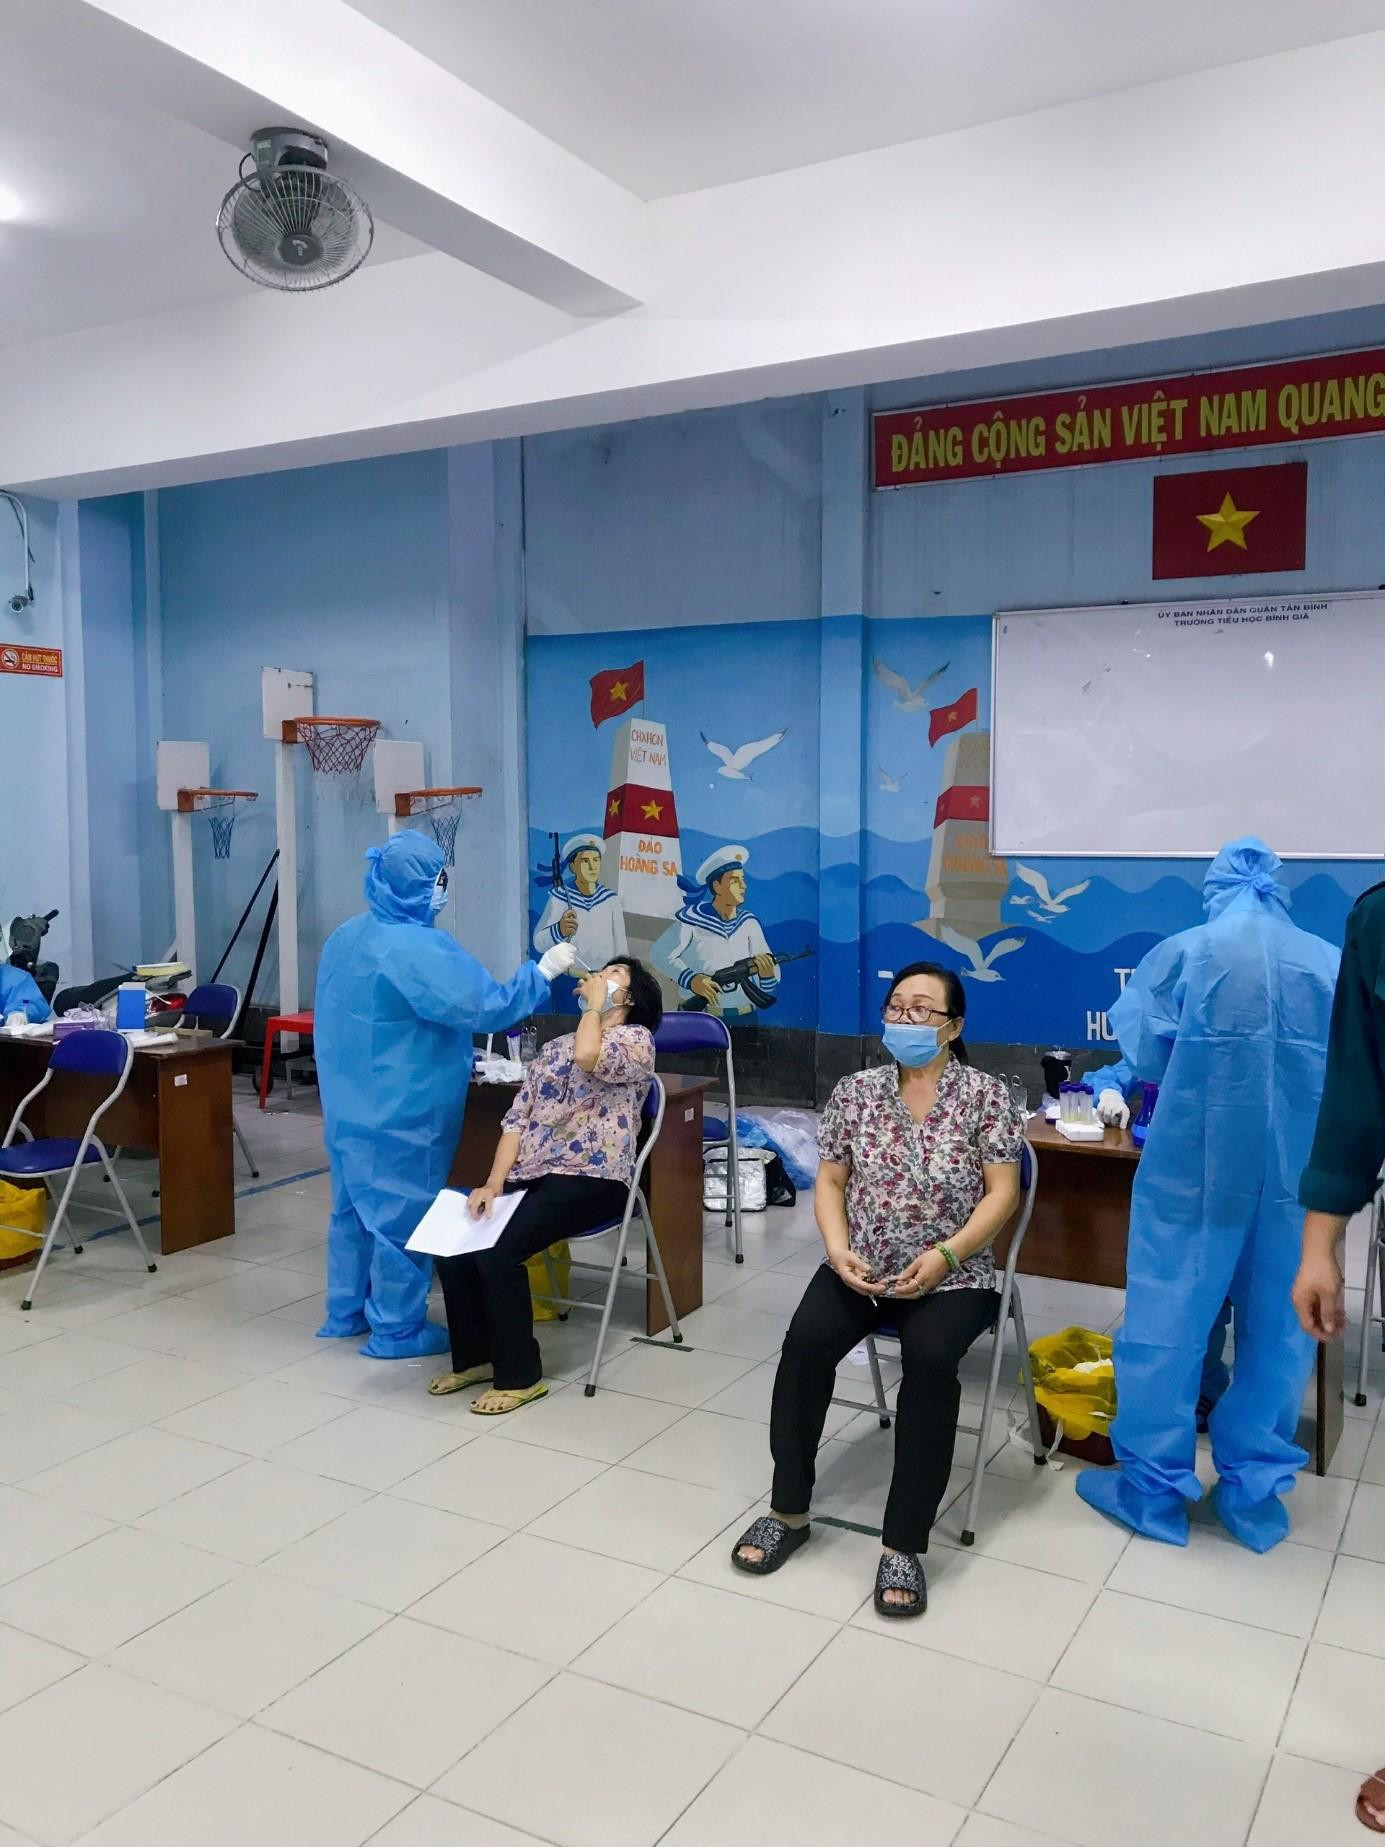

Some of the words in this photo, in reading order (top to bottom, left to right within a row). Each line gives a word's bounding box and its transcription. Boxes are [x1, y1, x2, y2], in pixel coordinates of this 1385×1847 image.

[890, 415, 964, 473] ĐẢNG
[971, 410, 1046, 469] CỘNG
[1055, 394, 1112, 454] SẢN
[1121, 389, 1189, 451] VIỆT
[1200, 388, 1267, 437] NAM
[1277, 372, 1385, 434] QUANG
[1196, 608, 1224, 617] NHÂN
[1226, 606, 1247, 615] DÂN
[1281, 603, 1301, 612] TÂN
[1303, 602, 1328, 611] BÌNH
[1241, 615, 1263, 624] HỌC
[1265, 613, 1290, 622] BÌNH
[631, 729, 664, 747] CHXHCN
[649, 753, 667, 767] NAM
[662, 862, 679, 877] SA
[1113, 968, 1137, 993] T
